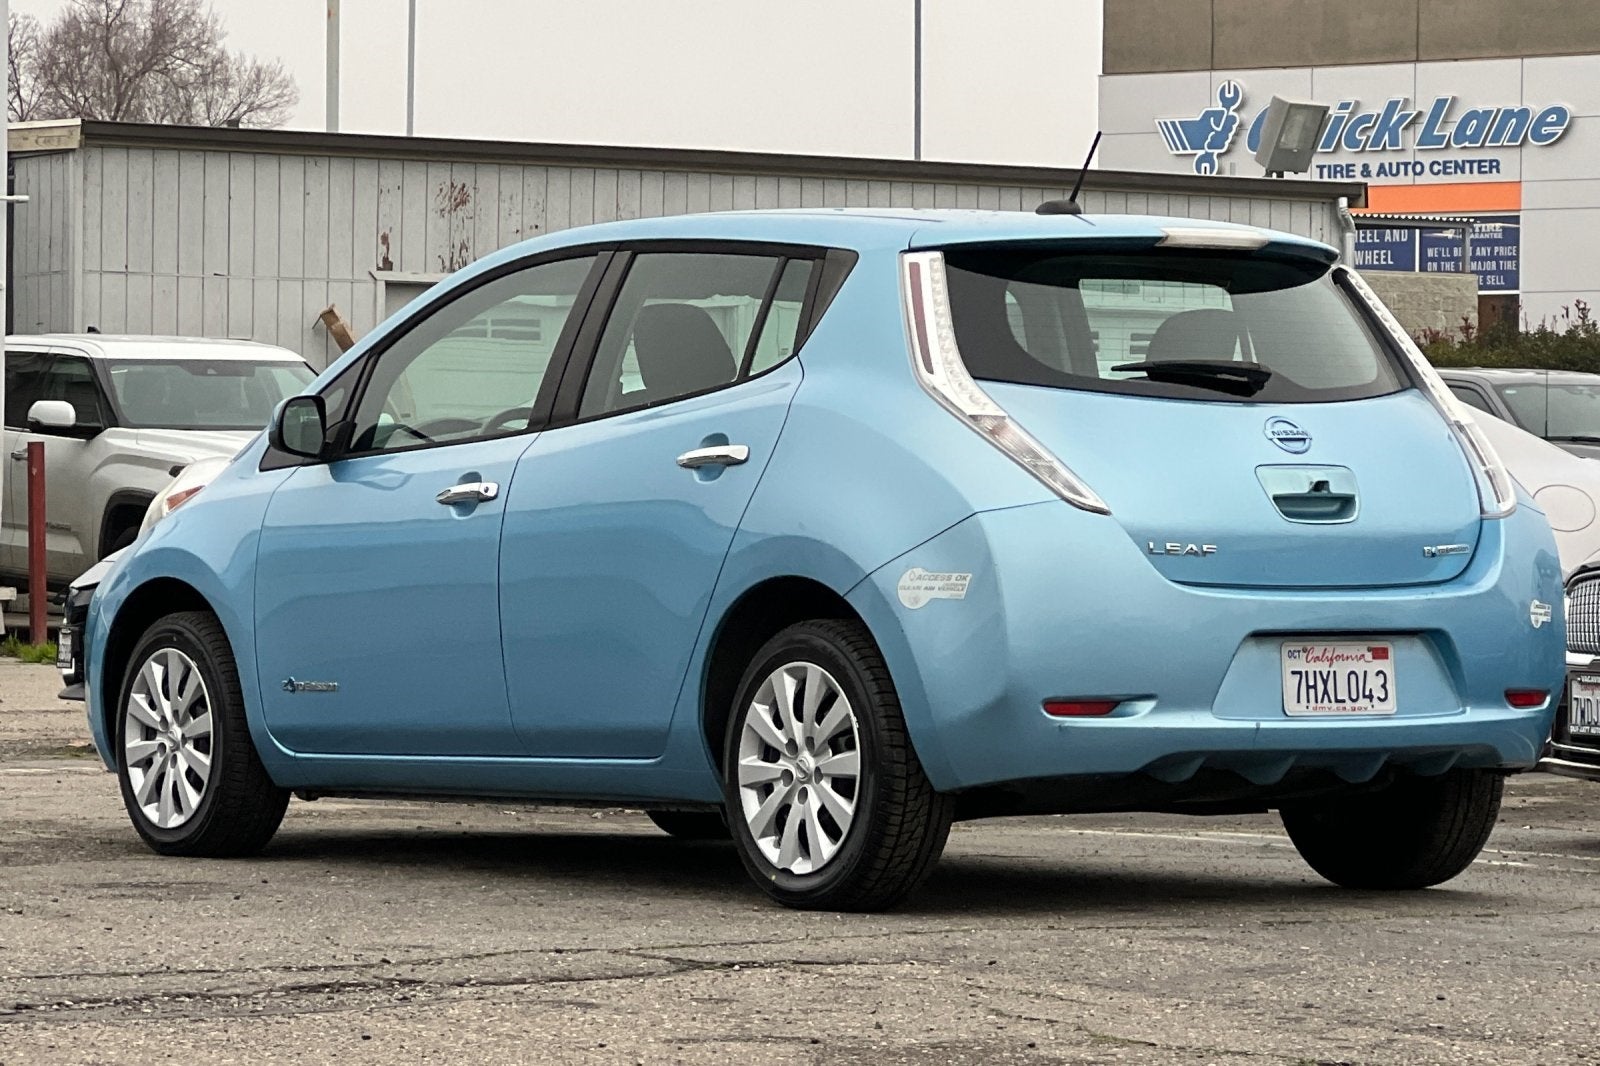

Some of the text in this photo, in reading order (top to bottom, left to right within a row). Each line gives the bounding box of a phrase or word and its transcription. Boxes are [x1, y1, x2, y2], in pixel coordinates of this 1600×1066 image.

[1246, 96, 1571, 153] ick Lane
[1316, 159, 1501, 180] TIRE & AUTO CENTER
[1384, 228, 1408, 242] AND
[1427, 247, 1451, 257] WE'LL
[1475, 246, 1493, 256] ANY
[1494, 245, 1517, 256] PRICE
[1427, 261, 1438, 271] ON
[1441, 261, 1455, 271] THE
[1470, 260, 1497, 271] MAJOR
[1499, 260, 1517, 270] TIRE
[1486, 275, 1505, 285] SELL
[1271, 430, 1309, 438] NISSAN
[1147, 541, 1217, 556] LEAF
[1287, 649, 1302, 659] OCT
[1305, 646, 1374, 668] California
[1290, 670, 1389, 704] 7HXL043
